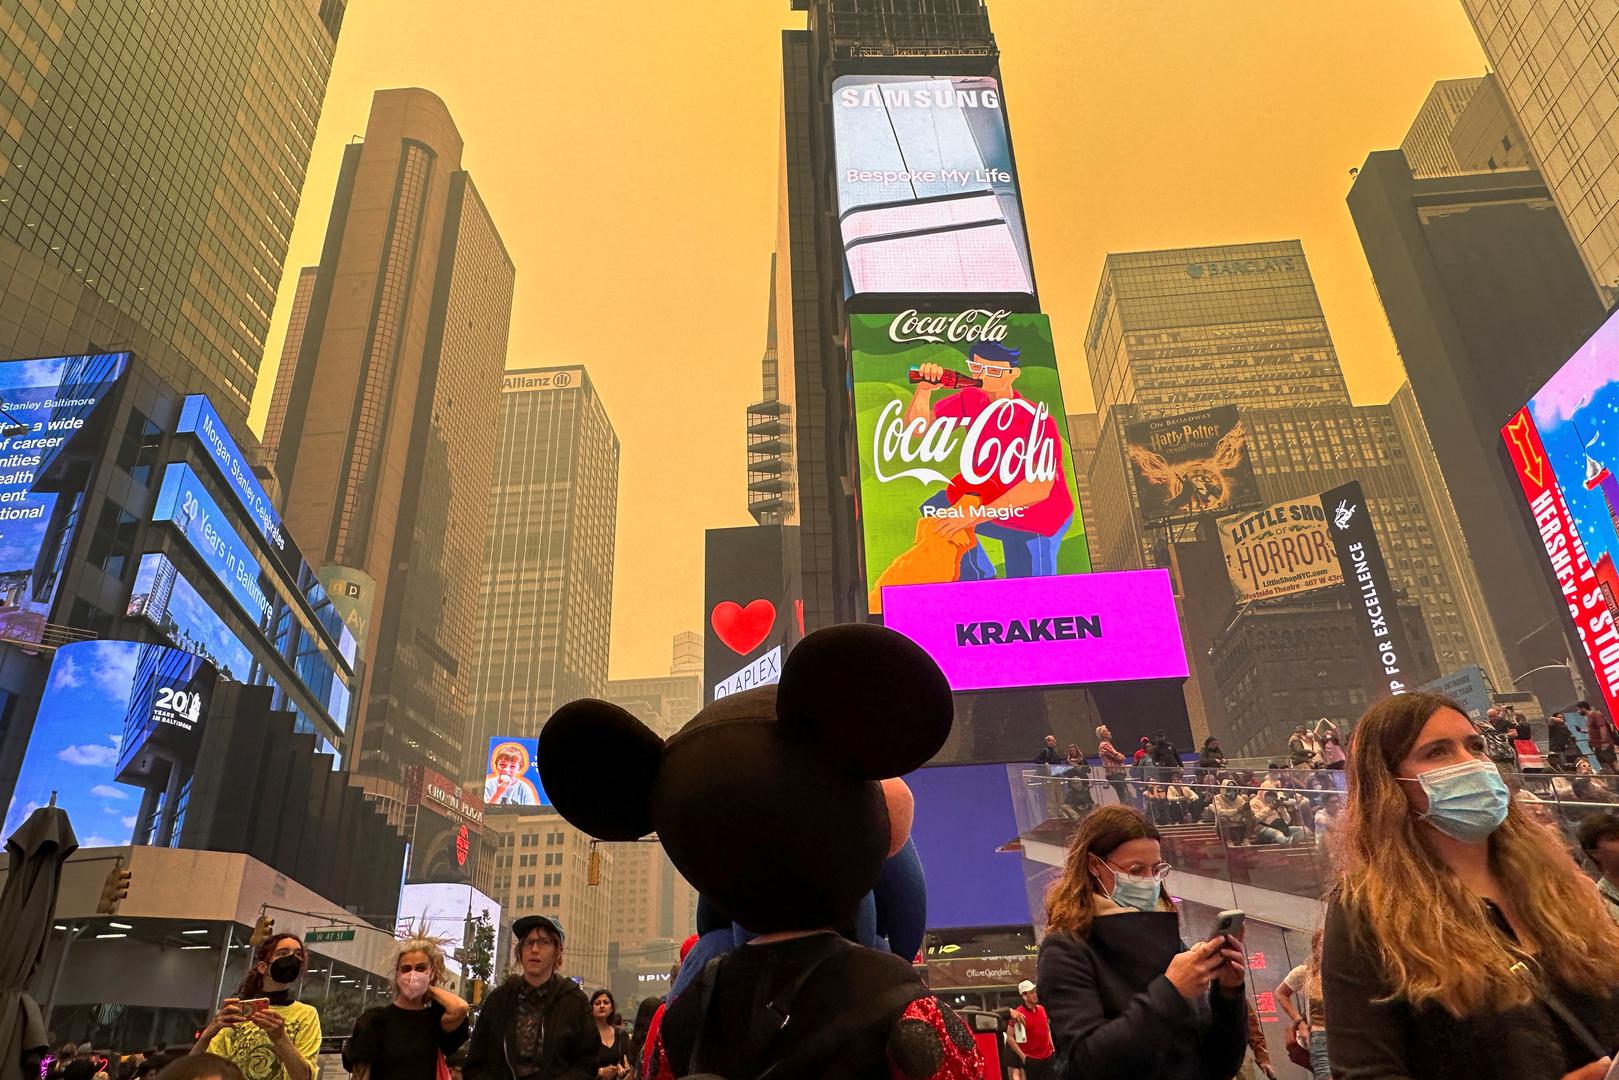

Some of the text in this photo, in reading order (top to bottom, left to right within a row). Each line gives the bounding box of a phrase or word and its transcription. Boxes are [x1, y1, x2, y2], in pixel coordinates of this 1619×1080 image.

[841, 88, 999, 109] SAMSUNG
[846, 168, 1011, 187] Bespoke My Life
[888, 308, 1012, 343] Coca-Cola
[503, 376, 551, 389] Allianz
[1, 397, 96, 411] Stanley Baltimore
[32, 422, 43, 432] a
[47, 416, 84, 431] wide
[1150, 413, 1211, 430] ON BROADWAY
[12, 436, 64, 451] career
[873, 398, 1056, 487] Coca-Cola
[1150, 430, 1183, 452] Harry
[1182, 424, 1220, 445] Potter
[203, 414, 286, 551] Morgan Stanley Celebrates
[0, 488, 28, 502] ent
[923, 505, 965, 519] Real
[1231, 507, 1287, 546] LITTLE
[1276, 527, 1287, 535] OF
[182, 490, 273, 621] 20 Years in Baltimore
[1262, 568, 1328, 588] LittleShopNYC.com
[1274, 584, 1301, 596] Theatre
[1349, 541, 1389, 638] EXCELLENCE
[955, 615, 1103, 647] KRAKEN
[1379, 640, 1401, 675] FOR
[155, 687, 188, 713] 20
[427, 784, 460, 809] CRONE
[966, 969, 985, 977] Olive
